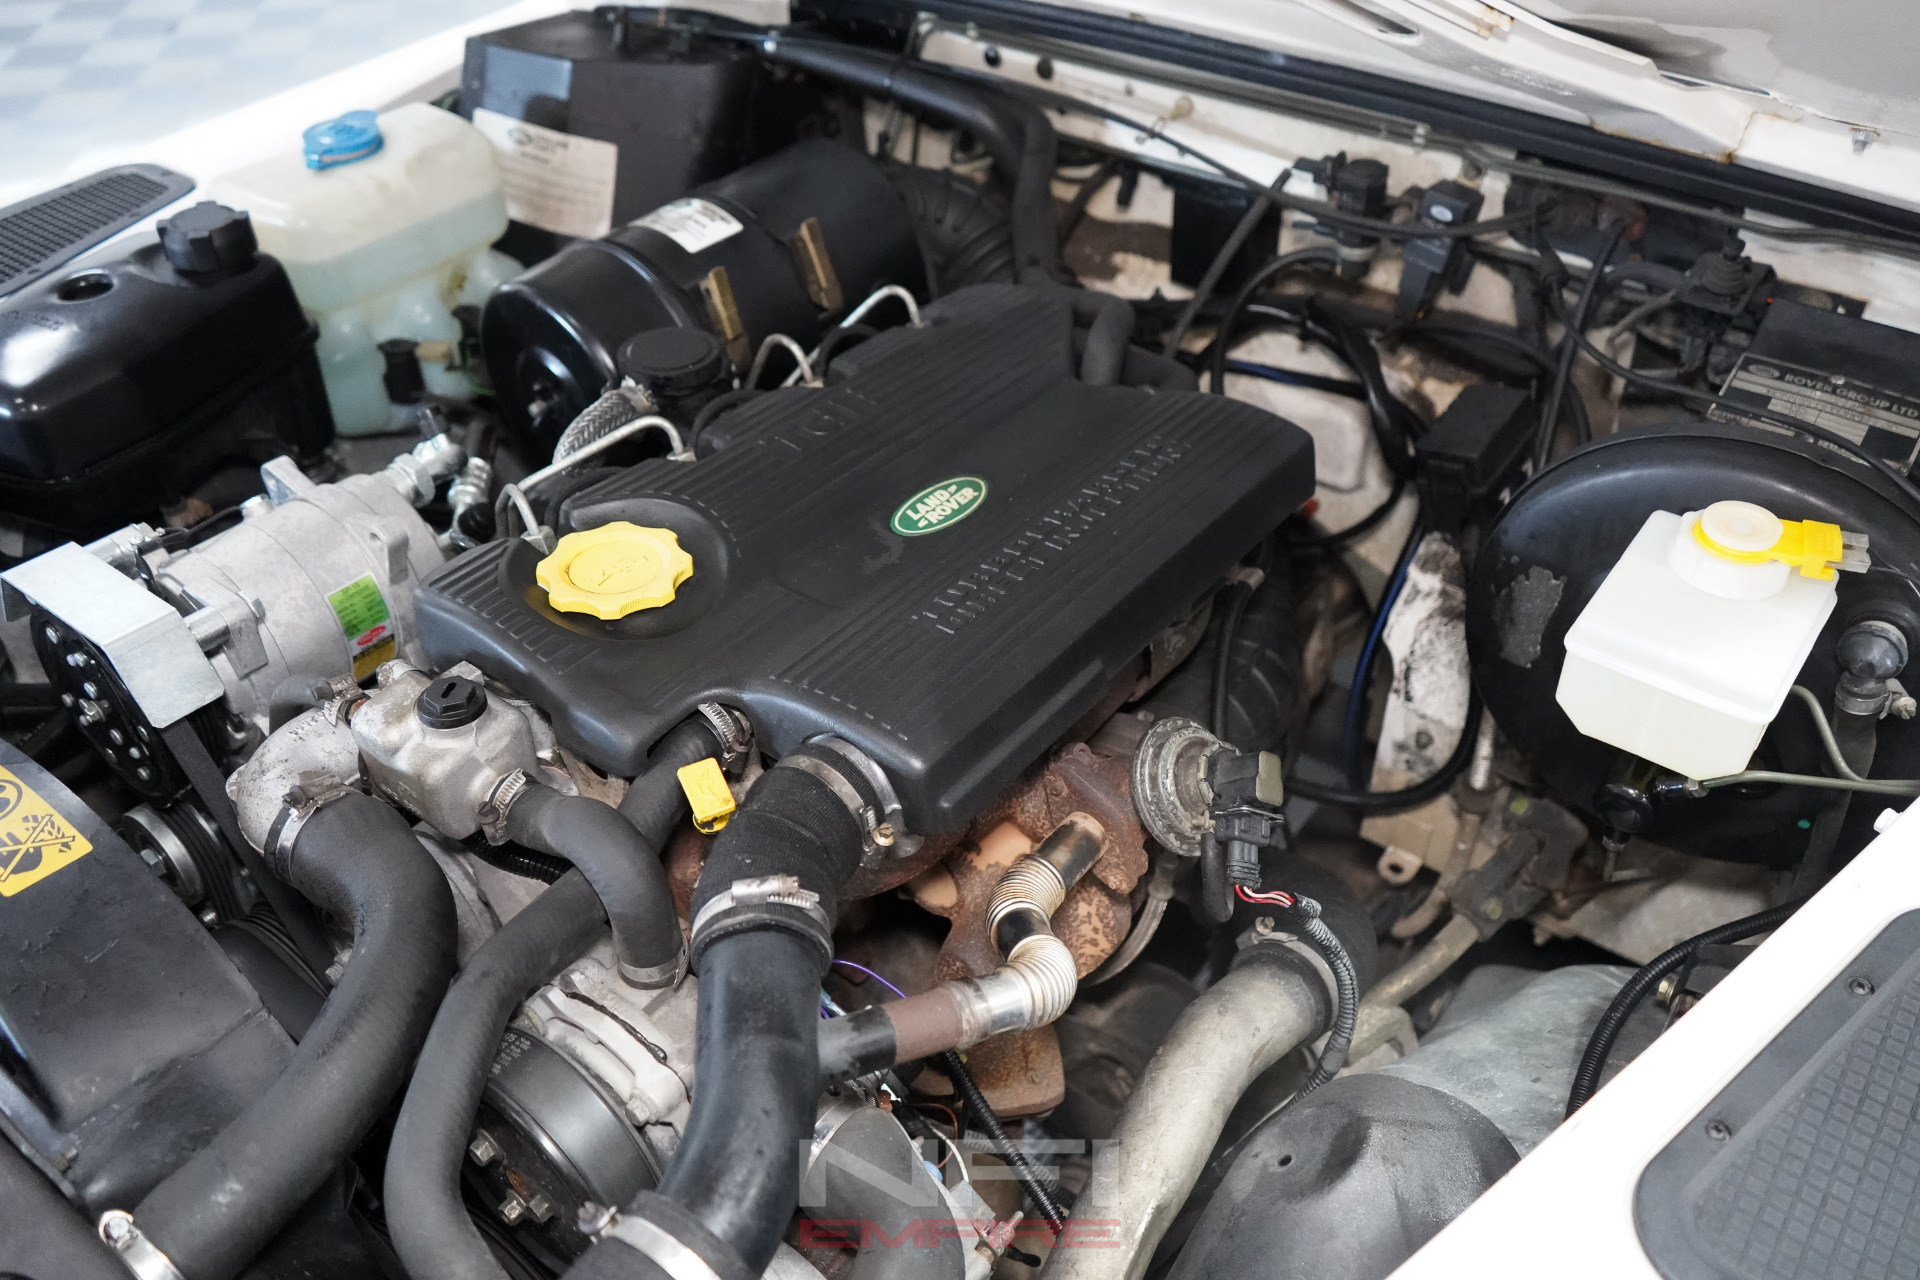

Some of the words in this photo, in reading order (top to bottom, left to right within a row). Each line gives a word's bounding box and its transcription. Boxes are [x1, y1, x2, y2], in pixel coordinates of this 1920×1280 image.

[1783, 373, 1835, 392] ROVER
[1835, 386, 1891, 412] GROUP
[1891, 404, 1920, 419] LTD
[905, 489, 952, 521] LAND
[924, 487, 980, 525] ROVER
